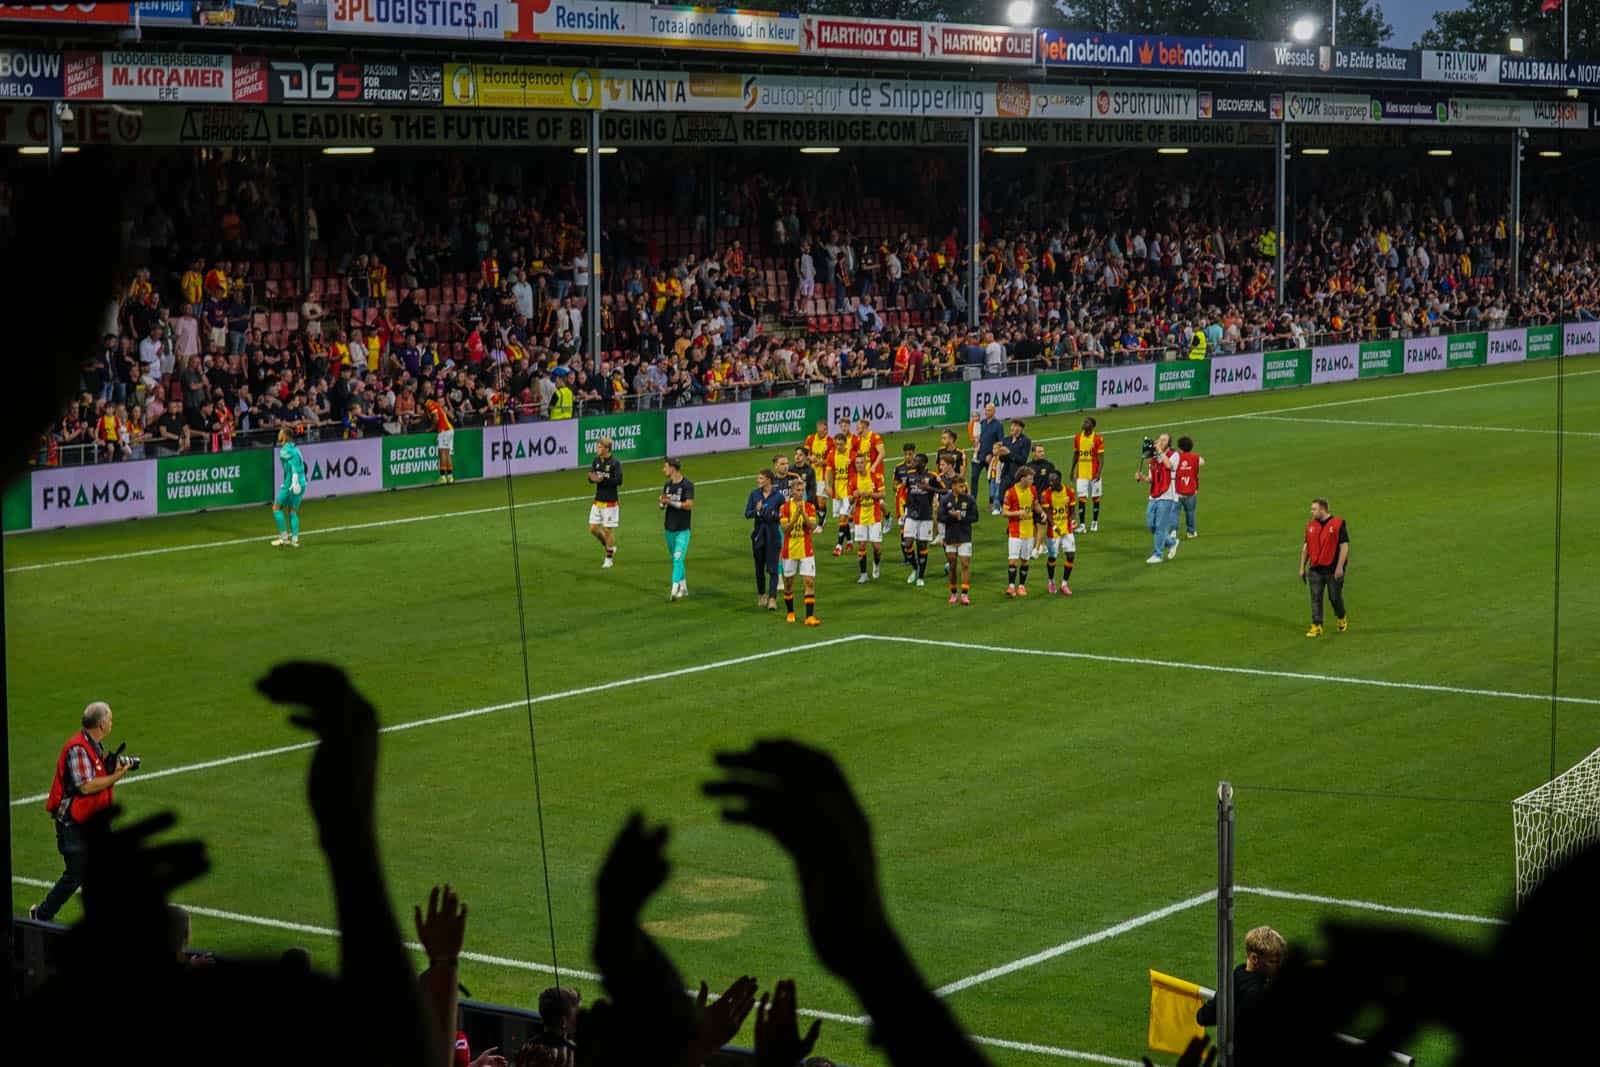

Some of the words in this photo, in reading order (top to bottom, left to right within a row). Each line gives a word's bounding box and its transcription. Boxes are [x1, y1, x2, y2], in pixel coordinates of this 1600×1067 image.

[556, 6, 625, 31] Rensink.
[650, 15, 753, 39] Totaalonderhoud
[757, 26, 766, 39] in
[768, 25, 795, 41] kleur
[821, 25, 886, 46] HARTHOLT
[890, 29, 919, 48] OLIE
[943, 33, 1002, 52] HARTHOLT
[1006, 36, 1032, 53] OLIE
[1159, 39, 1245, 68] betnation.nl
[1274, 48, 1315, 66] Wessels
[1336, 51, 1348, 66] De
[1350, 51, 1374, 68] Echte
[1376, 52, 1407, 71] Bakker
[1436, 53, 1487, 72] TRIVIUM
[0, 53, 60, 79] BOUW
[363, 63, 398, 77] PASSION
[1502, 60, 1568, 81] SMALBRAAK
[112, 67, 135, 86] M.
[137, 68, 224, 88] KRAMER
[363, 76, 380, 89] FOR
[484, 66, 564, 89] Hondgenoot
[1444, 72, 1479, 81] PACKAGING
[0, 82, 33, 97] MELO
[159, 87, 179, 100] EPE
[363, 87, 408, 101] EFFICIENCY
[762, 83, 843, 111] autobedrijf
[850, 81, 871, 107] de
[880, 82, 984, 115] Snipperling
[1113, 91, 1190, 115] SPORTUNITY
[1300, 97, 1321, 116] VDR
[1323, 103, 1368, 120] Bouwgroep
[277, 112, 383, 139] LEADING
[391, 114, 435, 139] THE
[444, 115, 529, 140] FUTURE
[537, 117, 562, 139] OF
[743, 118, 916, 142] RETROBRIDGE.COM
[982, 120, 1048, 143] LEADING
[1056, 121, 1082, 143] THE
[1088, 122, 1143, 143] FUTURE
[1148, 122, 1165, 143] OF
[1170, 123, 1233, 144] BRIDGING
[1490, 339, 1523, 354] FRAMO
[1566, 331, 1595, 346] FRAMO
[1407, 347, 1442, 362] FRAMO
[1040, 382, 1061, 394] BEZOEK
[1063, 380, 1080, 392] ONZE
[906, 395, 931, 408] BEZOEK
[933, 393, 951, 405] ONZE
[1040, 392, 1076, 404] WEBWINKEL
[756, 410, 783, 423] BEZOEK
[785, 408, 806, 420] ONZE
[906, 406, 946, 419] WEBWINKEL
[585, 426, 616, 441] BEZOEK
[619, 424, 641, 437] ONZE
[673, 418, 741, 442] FRAMO.NL
[756, 421, 801, 435] WEBWINKEL
[390, 445, 427, 462] BEZOEK
[491, 435, 568, 463] FRAMO.NL
[167, 469, 208, 484] BEZOEK
[211, 464, 241, 481] ONZE
[390, 458, 438, 476] WEBWINK
[43, 479, 144, 511] FRAMO.NL
[167, 480, 234, 500] WEBWINKEL
